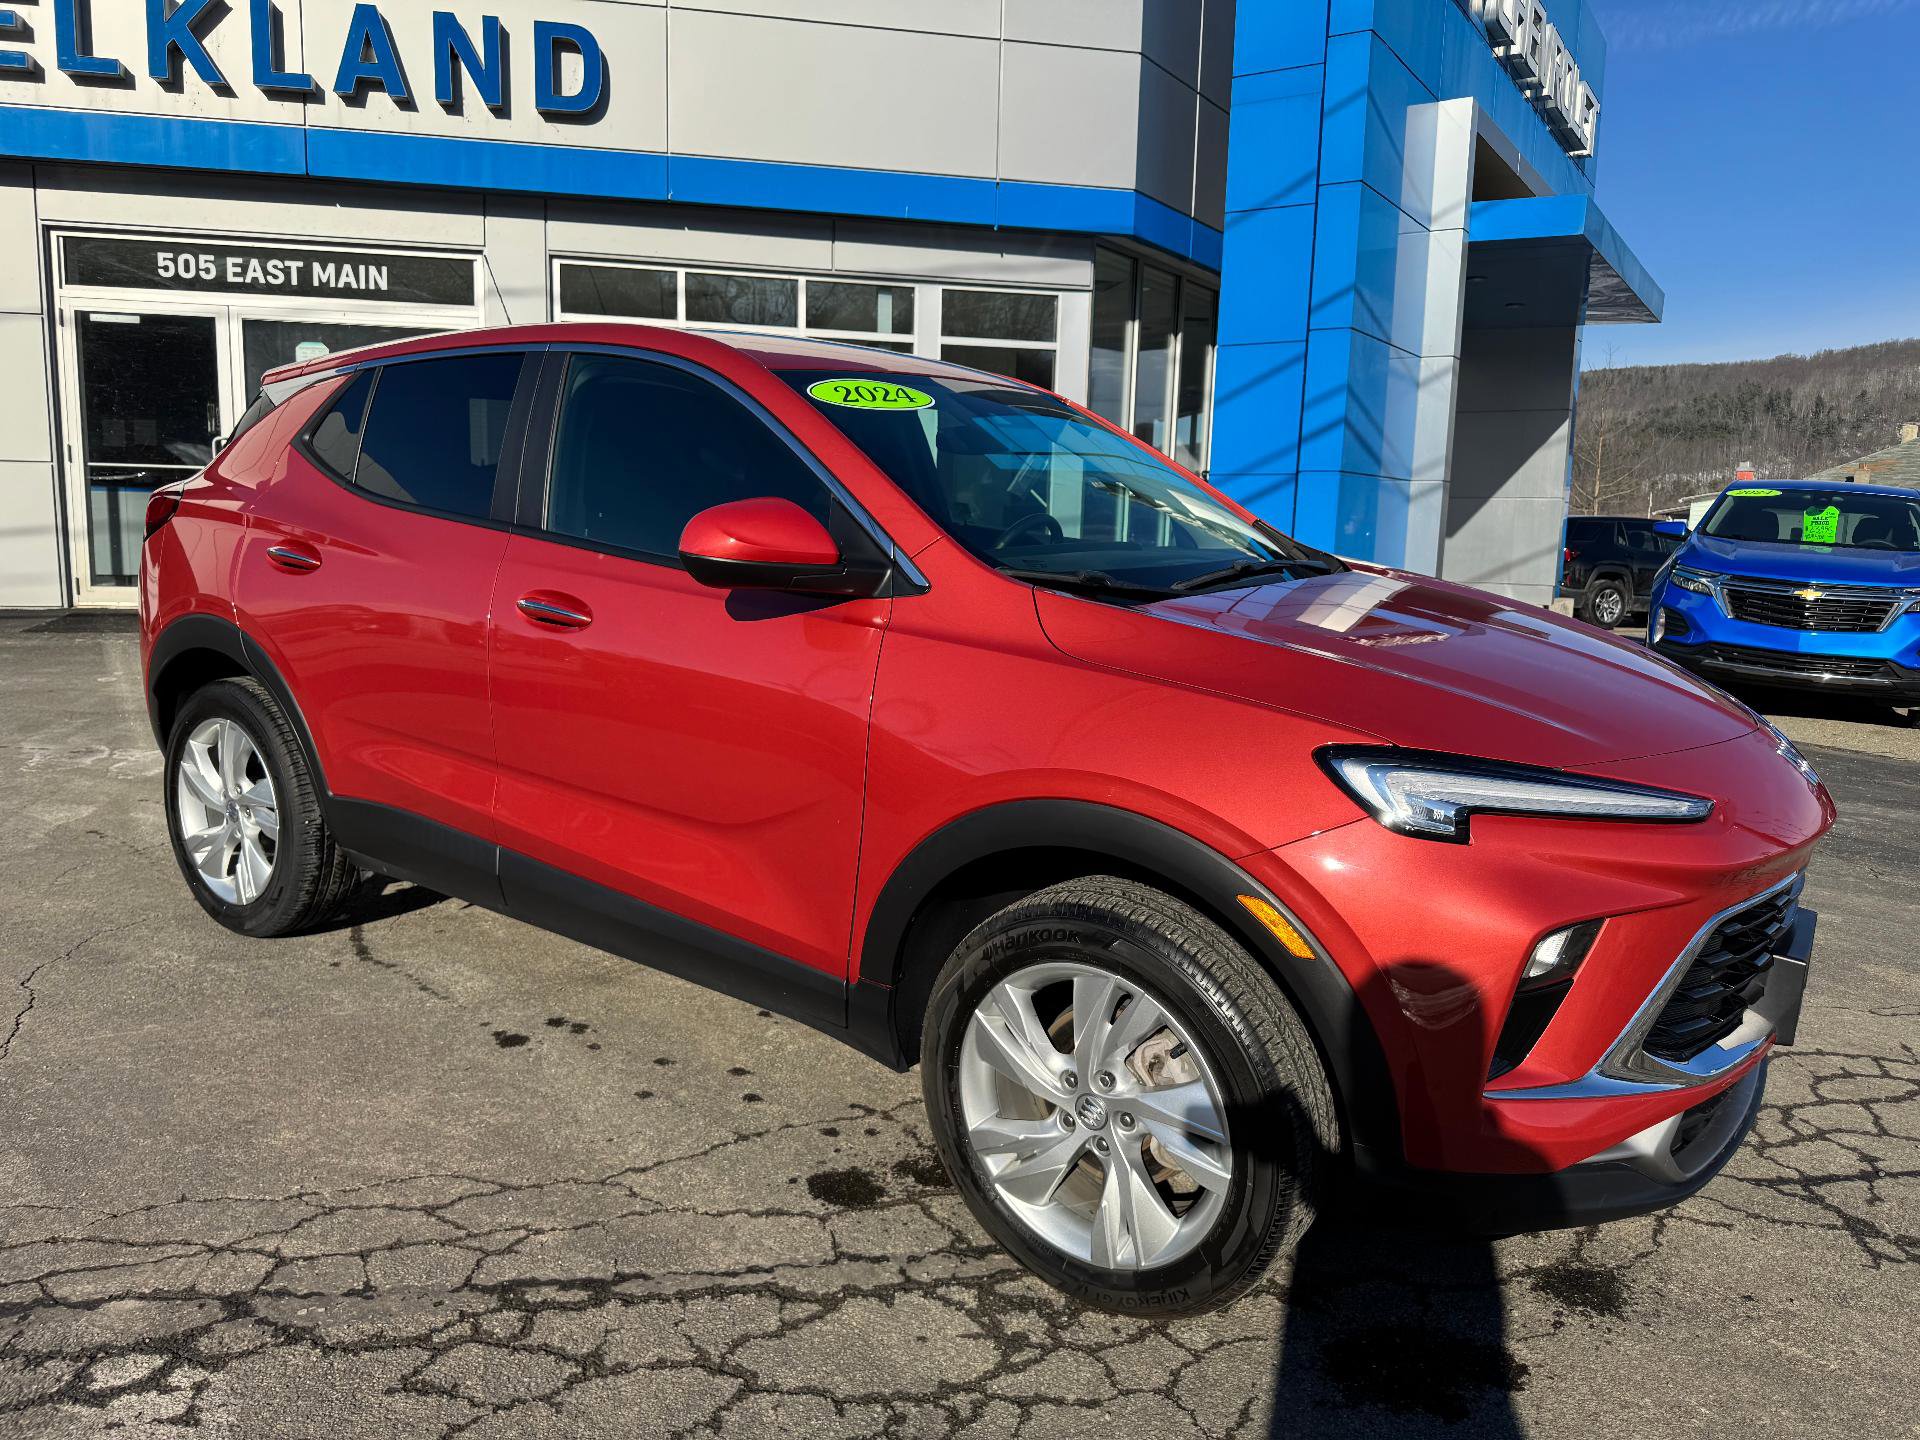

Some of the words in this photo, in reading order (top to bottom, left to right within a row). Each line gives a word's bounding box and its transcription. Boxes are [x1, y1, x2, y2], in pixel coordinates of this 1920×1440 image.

[157, 251, 217, 280] 505
[226, 257, 304, 287] EAST
[312, 262, 388, 291] MAIN
[833, 385, 918, 403] 2024
